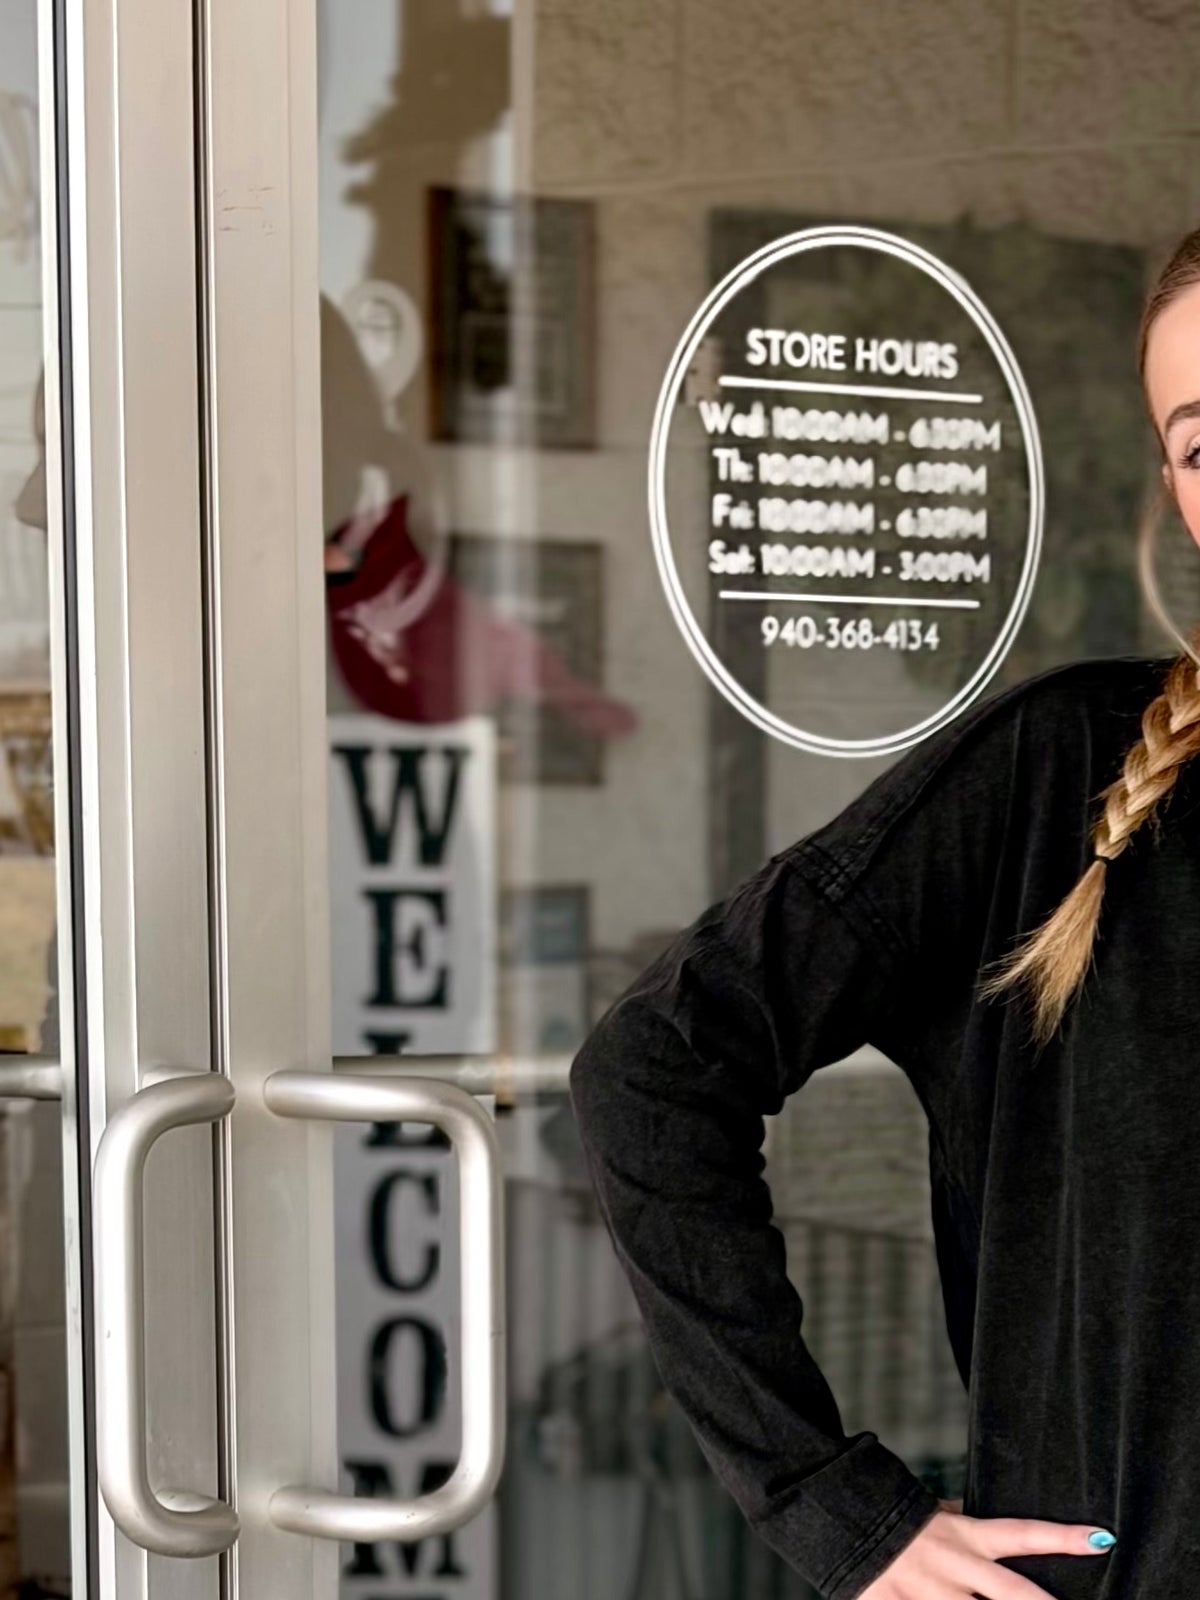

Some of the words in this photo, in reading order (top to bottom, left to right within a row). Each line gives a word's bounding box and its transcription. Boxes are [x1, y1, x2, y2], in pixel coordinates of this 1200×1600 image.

[745, 327, 847, 371] STORE
[854, 337, 959, 380] HOURS
[760, 615, 941, 652] 940-368-4134
